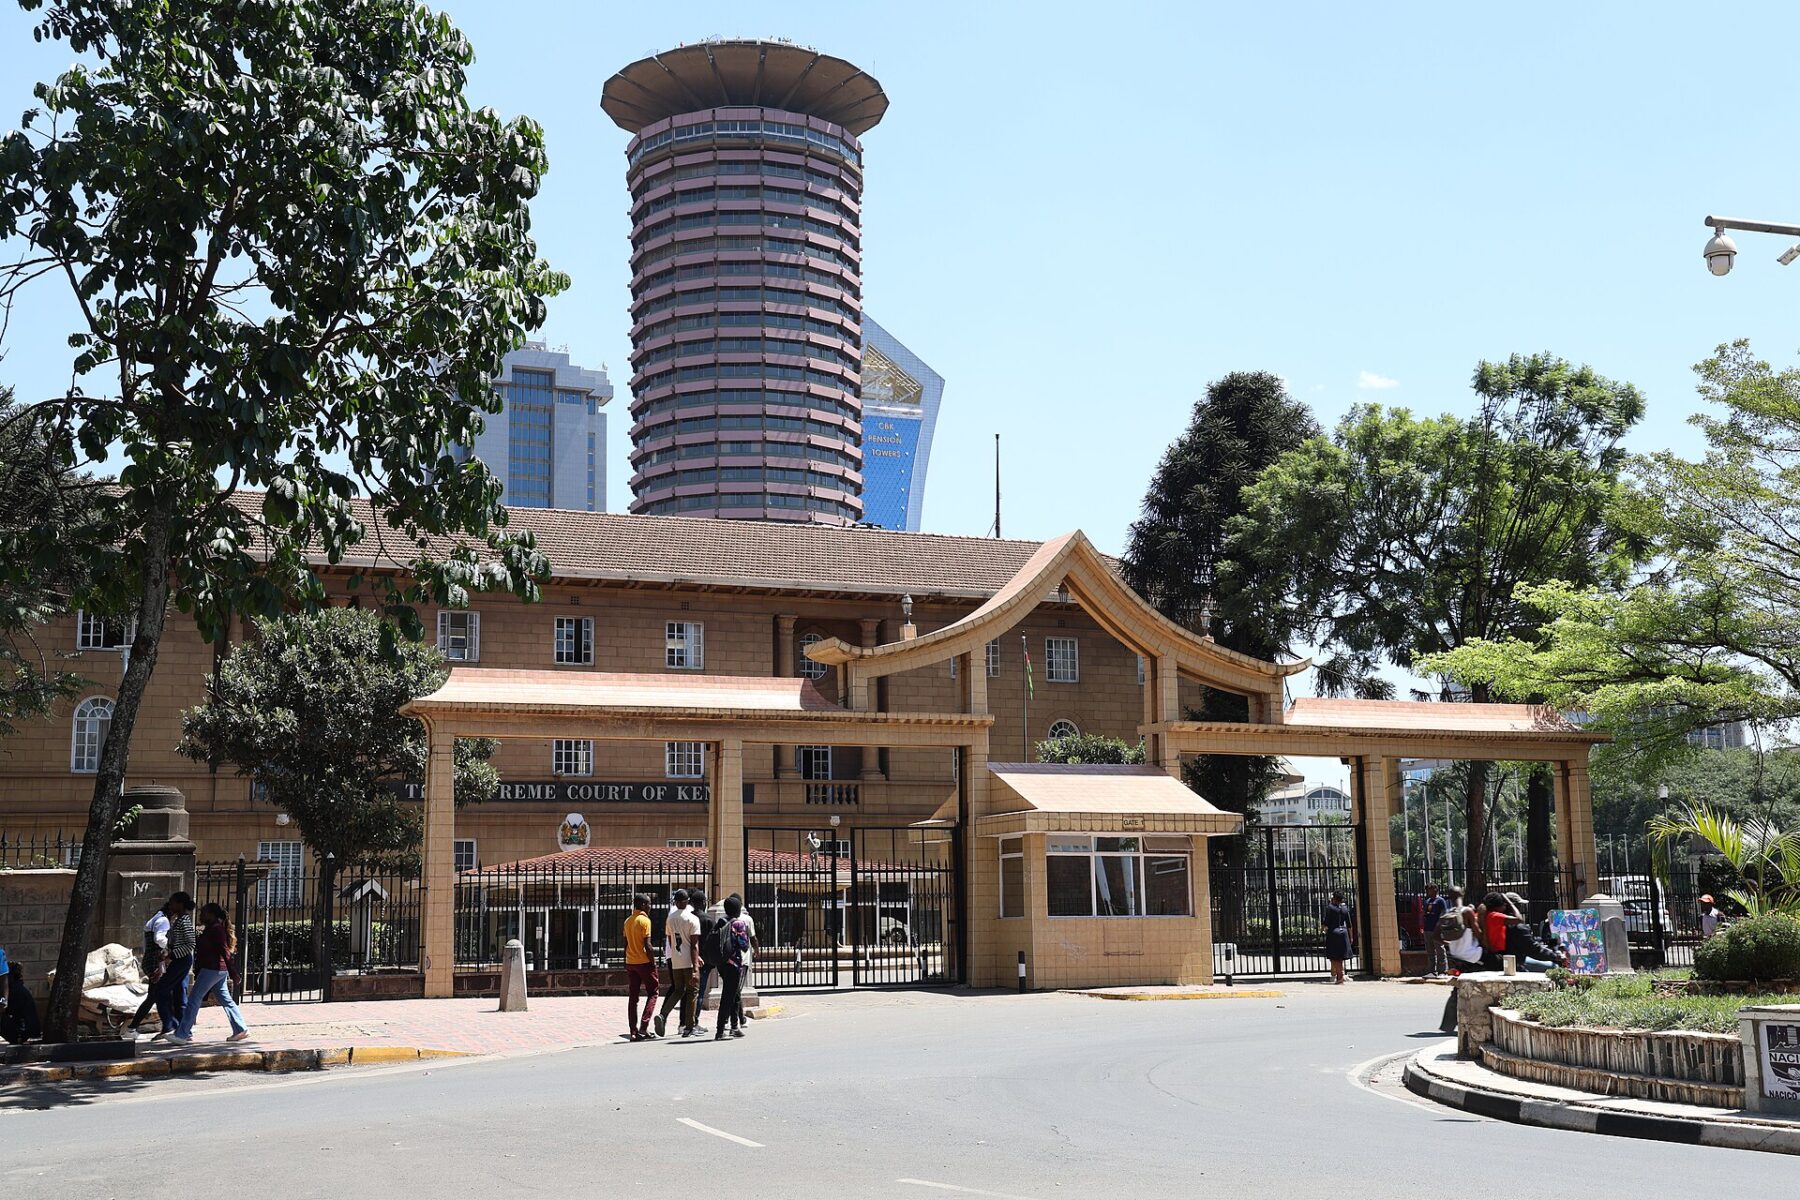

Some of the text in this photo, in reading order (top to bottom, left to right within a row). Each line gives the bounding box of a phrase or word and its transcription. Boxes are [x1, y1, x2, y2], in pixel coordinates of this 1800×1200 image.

[868, 434, 902, 445] PENSION
[871, 448, 901, 458] TOWERS
[567, 784, 634, 800] COURT
[641, 784, 667, 800] OF
[1769, 1089, 1798, 1100] NACICO
